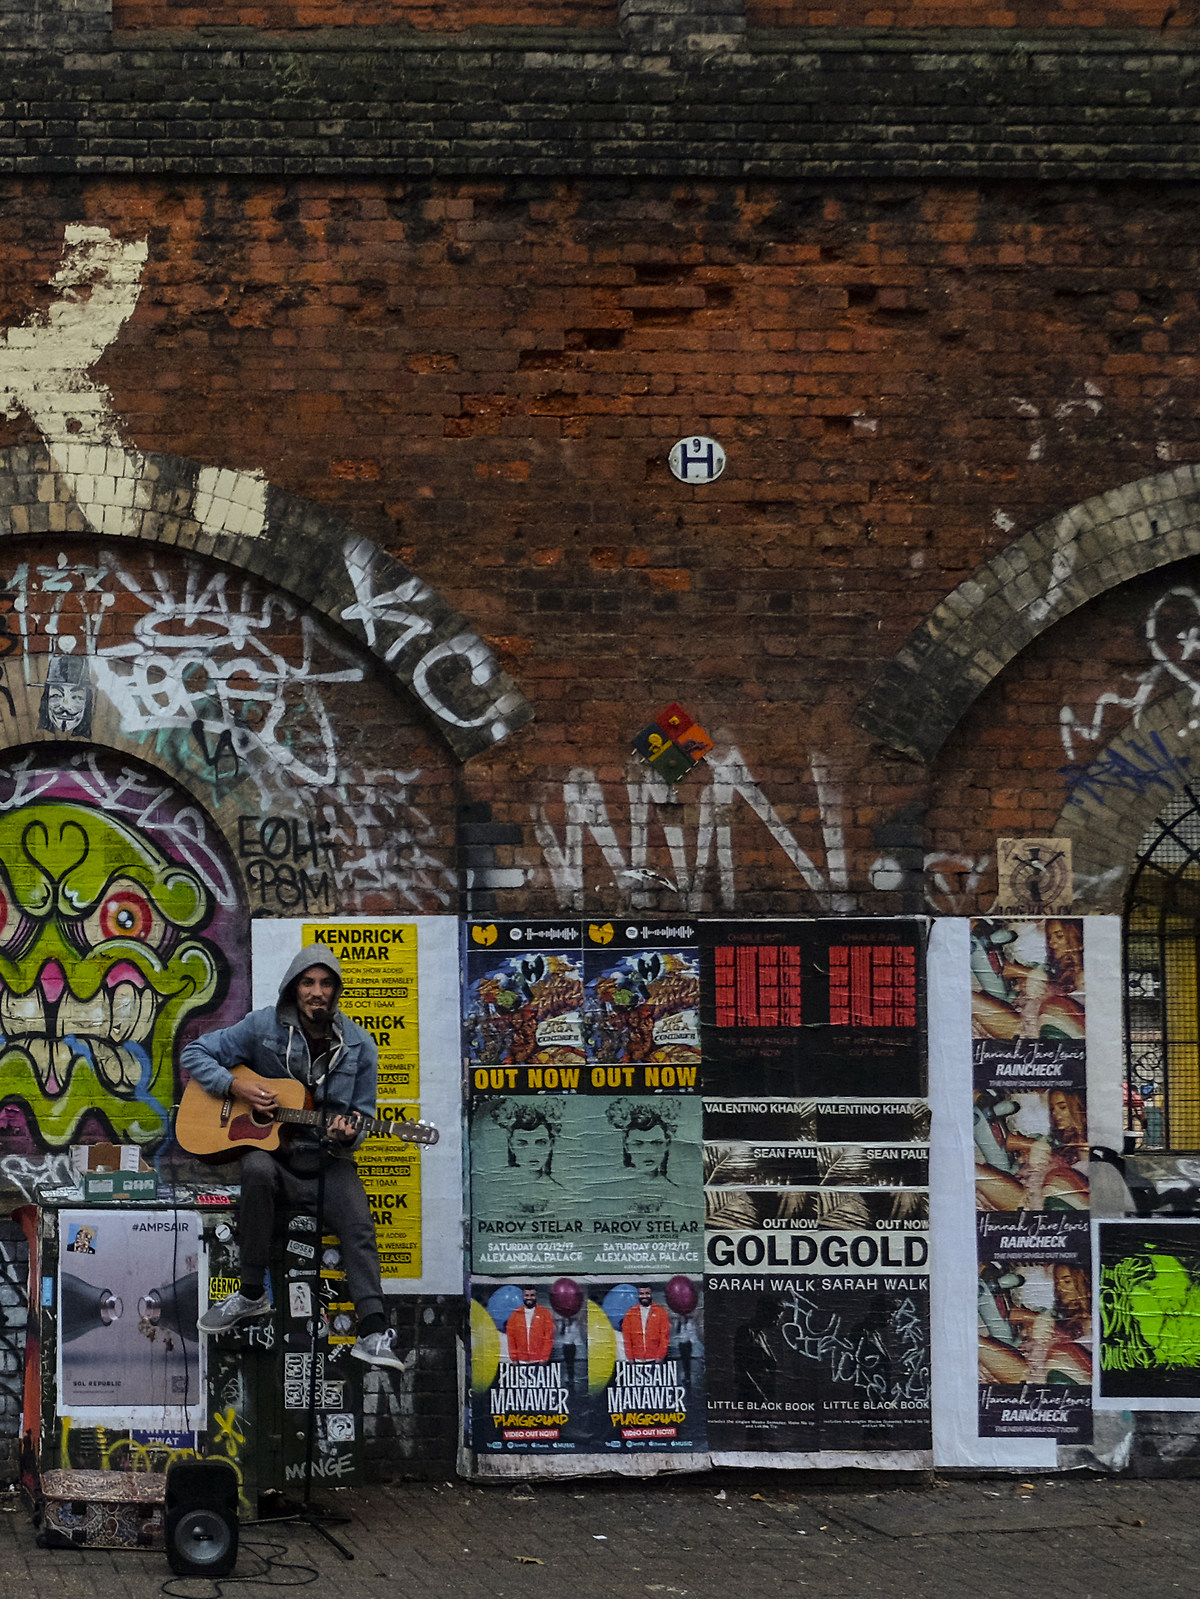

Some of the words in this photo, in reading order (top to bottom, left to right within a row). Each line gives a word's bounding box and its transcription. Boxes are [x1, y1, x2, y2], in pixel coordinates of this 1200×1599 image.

[693, 439, 701, 453] 9
[681, 444, 713, 478] H
[314, 929, 404, 943] KENDRICK
[995, 1063, 1064, 1076] RAINCHECK
[474, 1068, 519, 1089] OUT
[527, 1068, 580, 1089] NOW
[591, 1067, 635, 1088] OUT
[644, 1067, 697, 1088] NOW
[705, 1103, 768, 1113] VALENTINO
[770, 1104, 801, 1113] KHAN
[818, 1104, 880, 1115] VALENTINO
[883, 1105, 915, 1114] KHAN
[753, 1148, 786, 1159] SEAN
[788, 1148, 817, 1159] PAUL
[866, 1149, 899, 1159] SEAN
[901, 1150, 928, 1159] PAUL
[371, 1167, 410, 1175] RELEASED
[132, 1222, 189, 1232] #AMPSAIR
[478, 1220, 526, 1233] PAROV
[531, 1220, 583, 1233] STELAR
[593, 1220, 641, 1233] PAROV
[647, 1220, 699, 1233] STELAR
[762, 1219, 788, 1229] OUT
[790, 1219, 818, 1229] NOW
[875, 1220, 901, 1230] OUT
[903, 1220, 929, 1230] NOW
[289, 1240, 314, 1255] LOSER
[385, 1242, 418, 1250] WEMBLEY
[488, 1242, 535, 1251] SATURDAY
[537, 1242, 574, 1251] 02/12/17
[603, 1242, 649, 1251] SATURDAY
[652, 1242, 690, 1251] 02/12/17
[1000, 1235, 1068, 1248] RAINCHECK
[479, 1252, 541, 1262] ALEXANDRA
[543, 1252, 583, 1262] PALACE
[594, 1252, 656, 1262] ALEXANDRA
[659, 1252, 699, 1262] PALACE
[707, 1234, 818, 1267] GOLD
[820, 1235, 928, 1268] GOLD
[210, 1280, 240, 1293] GERNO
[708, 1278, 764, 1291] SARAH
[770, 1279, 816, 1292] WALK
[821, 1278, 878, 1291] SARAH
[884, 1278, 929, 1291] WALK
[498, 1362, 561, 1389] HUSSAIN
[615, 1360, 678, 1387] HUSSAIN
[490, 1388, 570, 1415] MANAWER
[607, 1386, 687, 1413] MANAWER
[823, 1401, 859, 1410] LITTLE
[863, 1400, 898, 1410] BLACK
[900, 1400, 930, 1410] BOOK
[707, 1401, 744, 1411] LITTLE
[747, 1401, 783, 1411] BLACK
[785, 1402, 816, 1412] BOOK
[493, 1414, 569, 1428] PLAYGROUND
[611, 1412, 686, 1427] PLAYGROUND
[1001, 1409, 1069, 1422] RAINCHECK
[147, 1437, 180, 1446] TWAT
